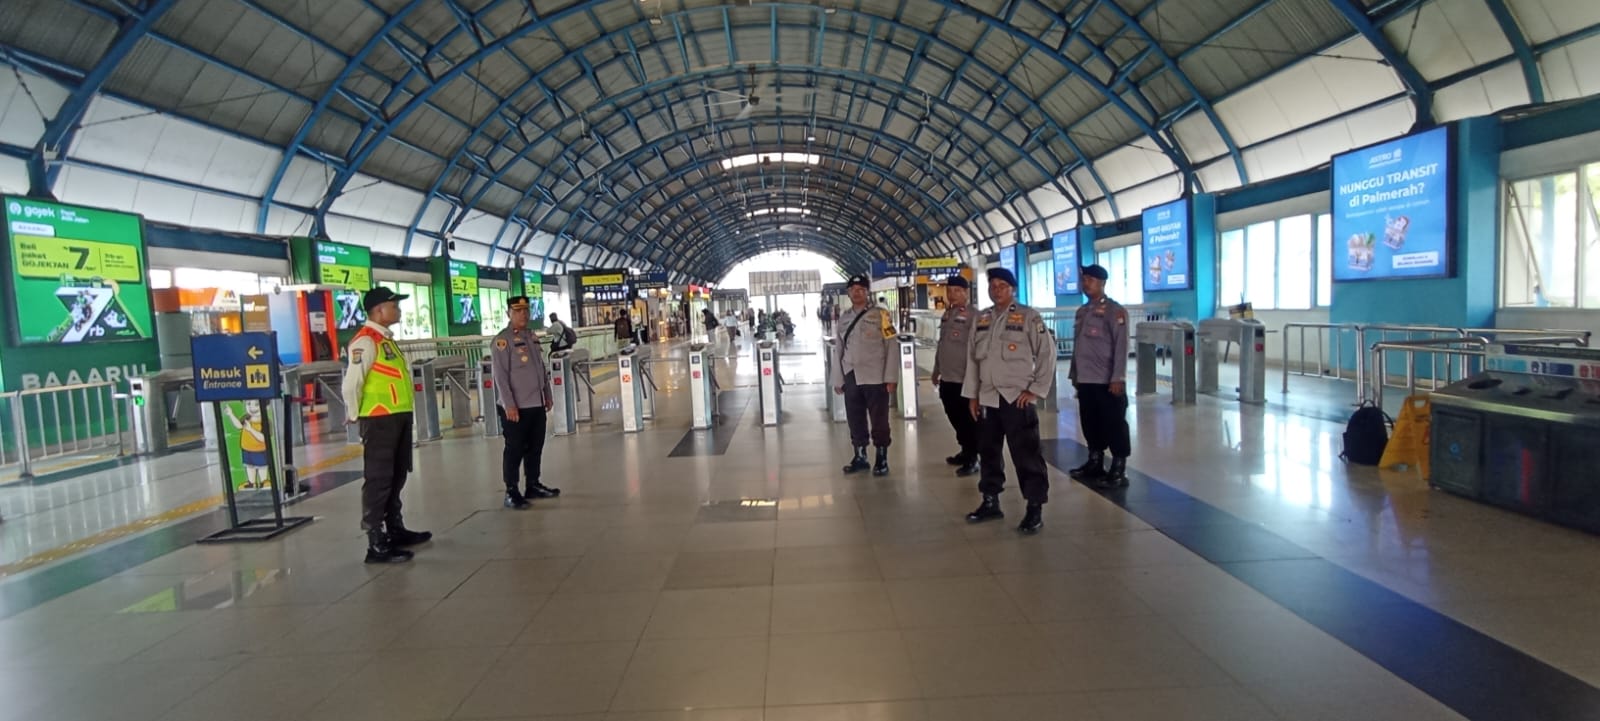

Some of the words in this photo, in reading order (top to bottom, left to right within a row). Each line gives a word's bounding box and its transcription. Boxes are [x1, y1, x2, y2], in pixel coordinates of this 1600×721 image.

[1340, 175, 1384, 195] NUNGGU
[1386, 163, 1438, 184] TRANSIT
[1349, 193, 1359, 207] di
[1362, 182, 1425, 205] Palmerah?
[24, 205, 55, 217] gojek
[69, 246, 90, 270] 7
[89, 325, 105, 337] rb
[200, 367, 241, 379] Masuk
[203, 380, 242, 390] Entrance
